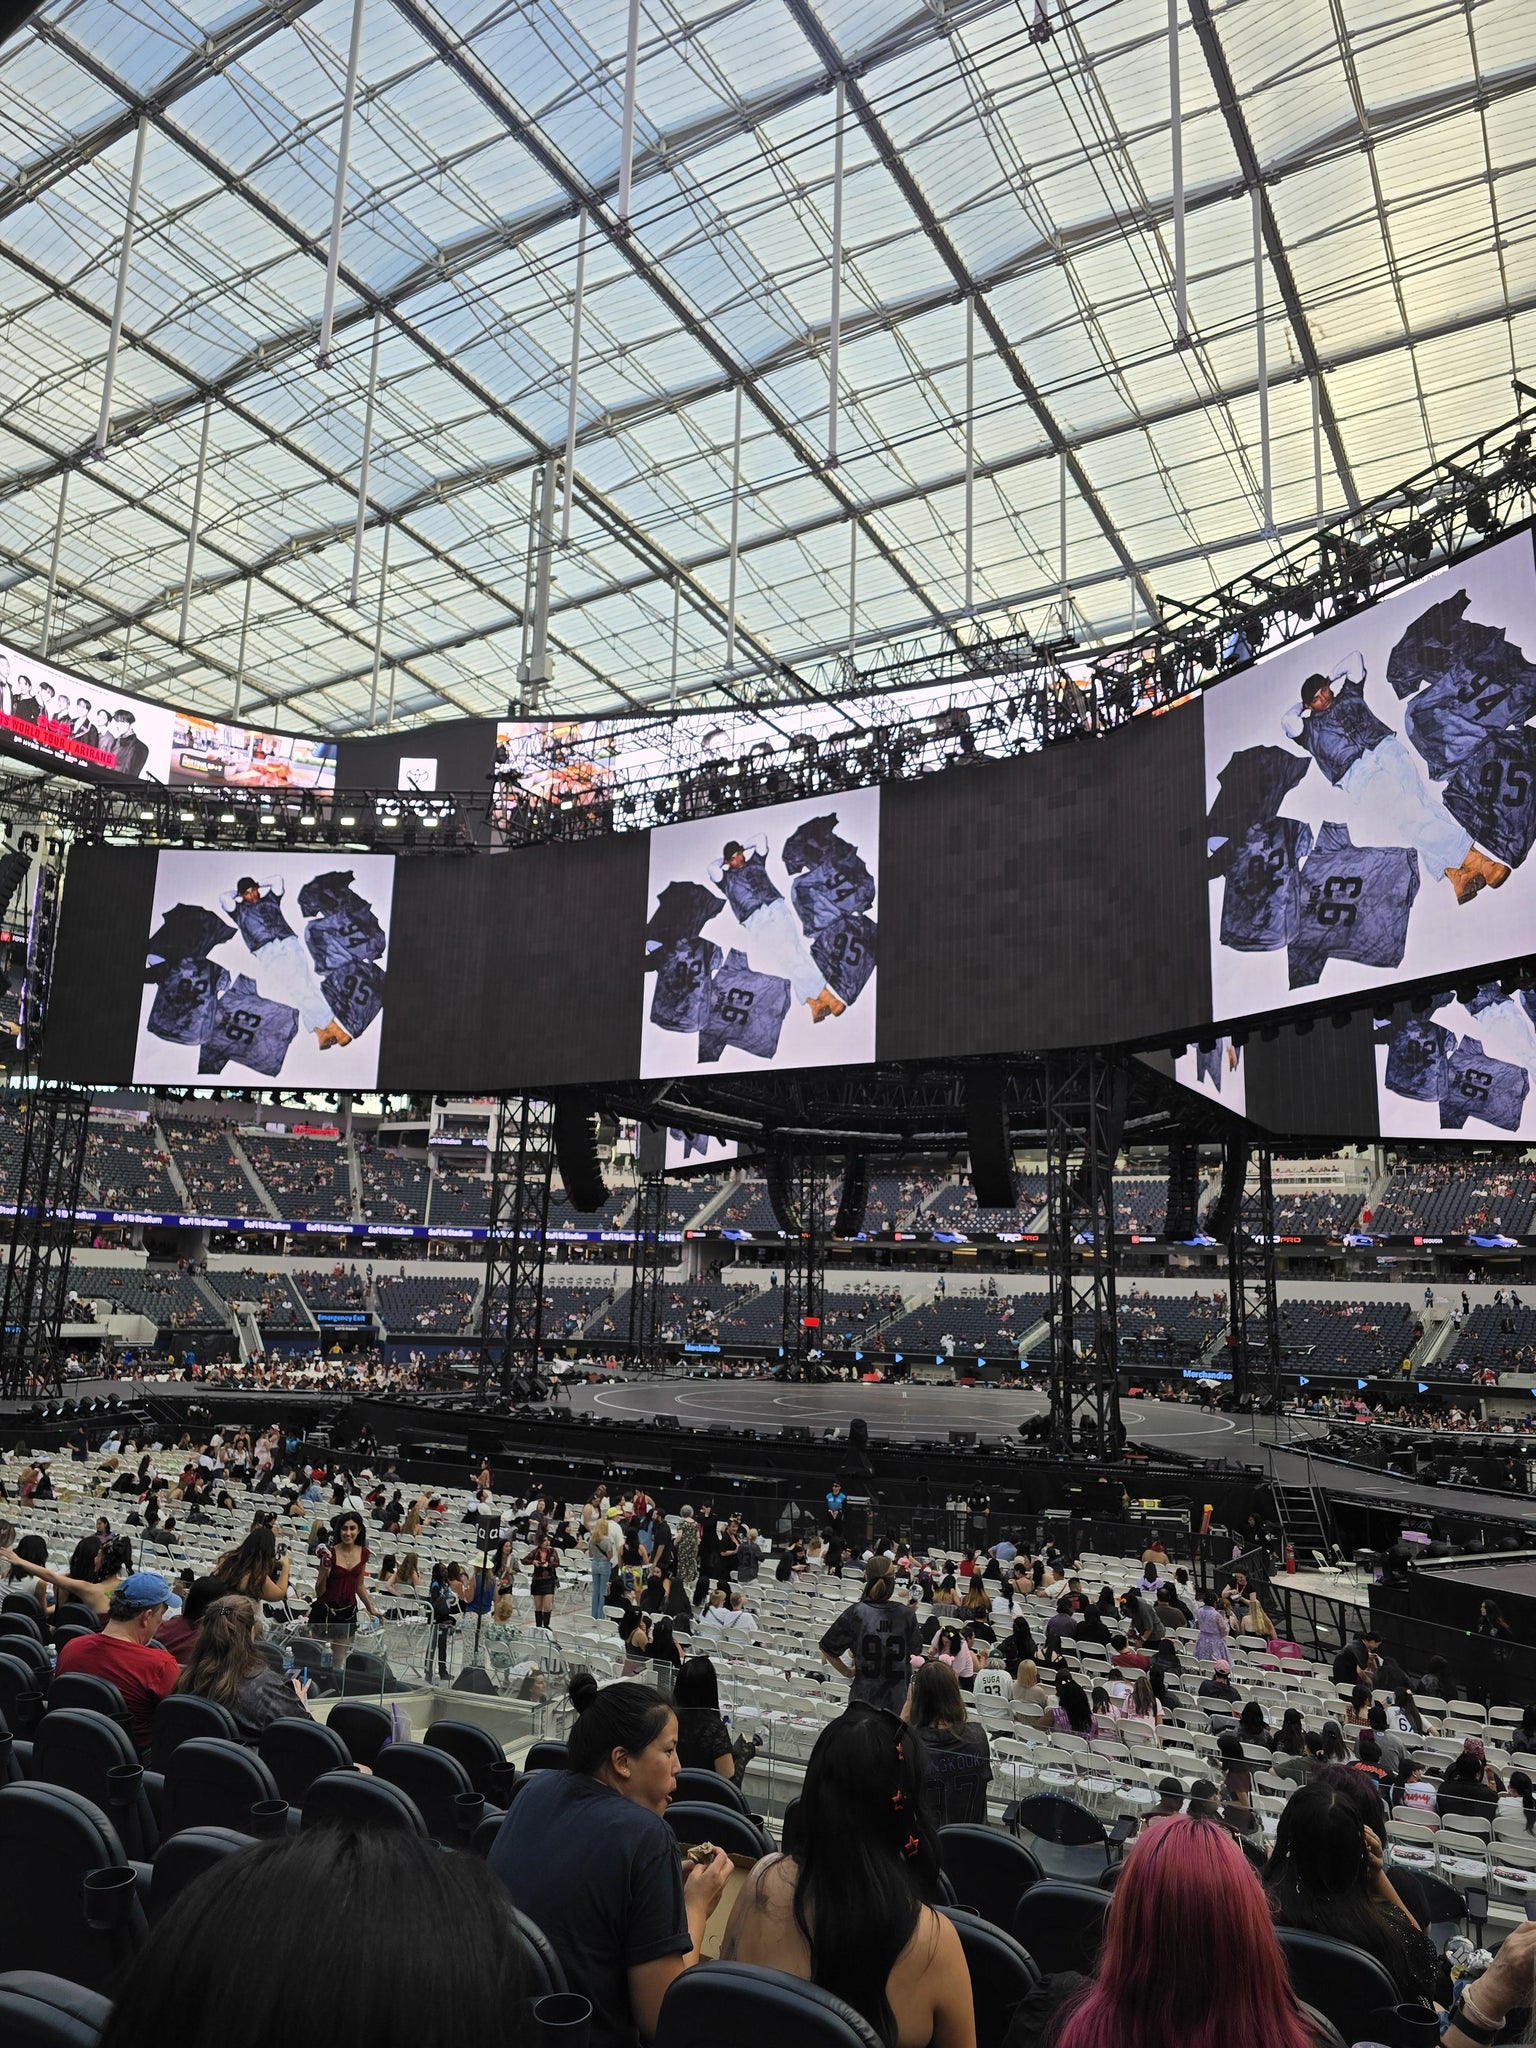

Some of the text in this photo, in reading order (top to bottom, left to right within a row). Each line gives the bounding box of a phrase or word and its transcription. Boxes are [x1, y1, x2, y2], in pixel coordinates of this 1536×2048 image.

[0, 713, 9, 726] TS
[12, 719, 40, 739] WORLD
[43, 732, 65, 748] TOUR
[75, 744, 112, 764] ARIRANG
[1476, 762, 1527, 807] 95
[1317, 876, 1363, 927] 93
[832, 932, 865, 967] 95
[340, 974, 371, 1006] 95
[721, 987, 754, 1026] 93
[226, 1009, 262, 1044] 93
[1460, 1068, 1493, 1101] 93
[135, 1214, 162, 1225] Stadium
[202, 1218, 228, 1228] Stadium
[265, 1221, 291, 1231] Stadium
[328, 1224, 353, 1233] Stadium
[317, 1313, 366, 1322] Emergency Exit
[1183, 1370, 1232, 1380] Merchandise
[876, 1620, 893, 1633] JIN
[861, 1634, 906, 1679] 92
[982, 1676, 1000, 1684] SUGA
[929, 1752, 980, 1773] NGKOOK
